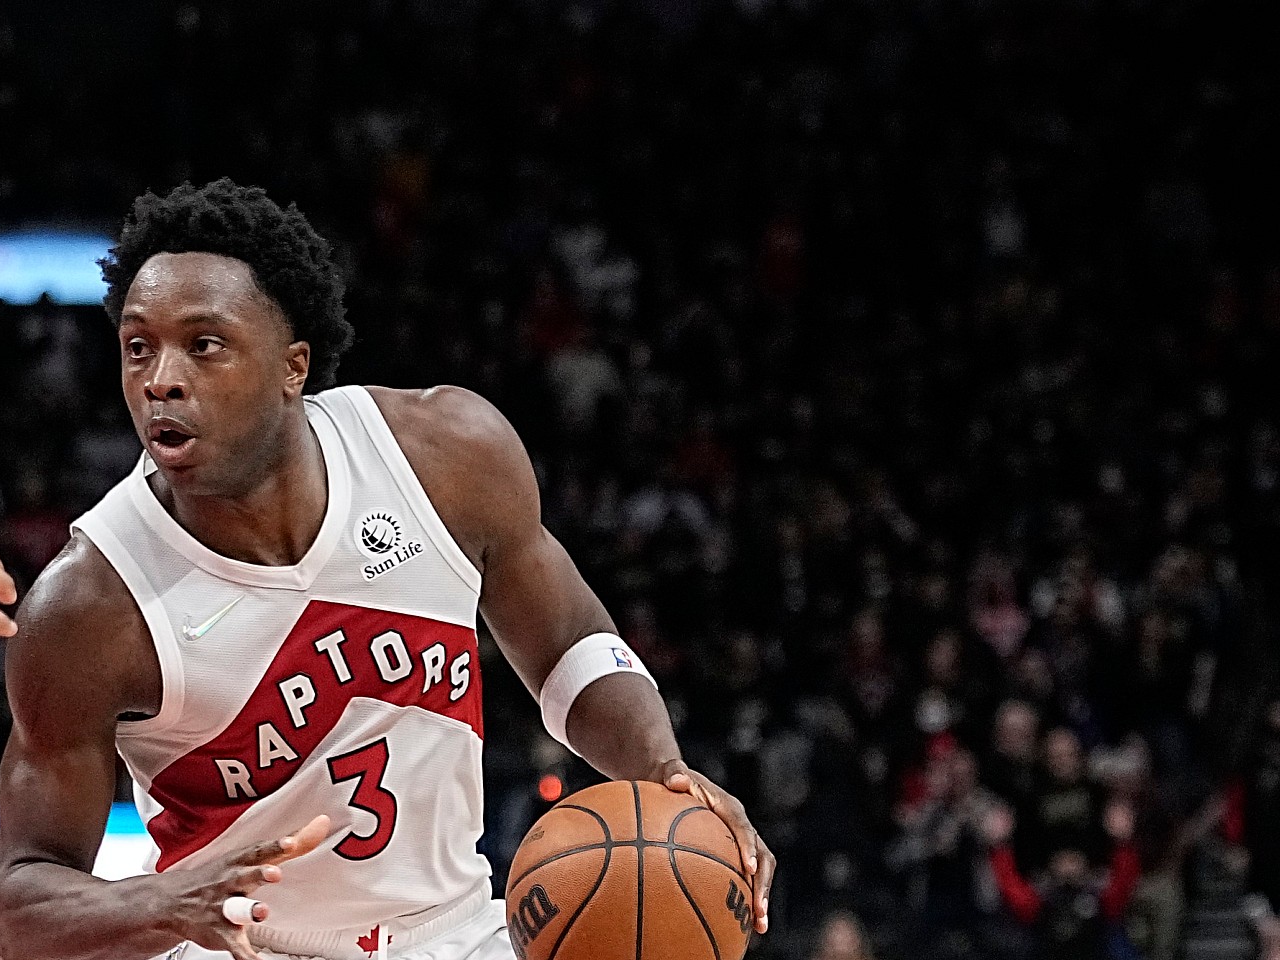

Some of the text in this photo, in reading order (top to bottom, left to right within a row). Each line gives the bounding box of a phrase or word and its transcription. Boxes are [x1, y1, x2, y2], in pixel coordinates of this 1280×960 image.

[363, 541, 424, 579] Sun Life
[213, 629, 471, 800] RAPTORS
[326, 736, 398, 861] 3
